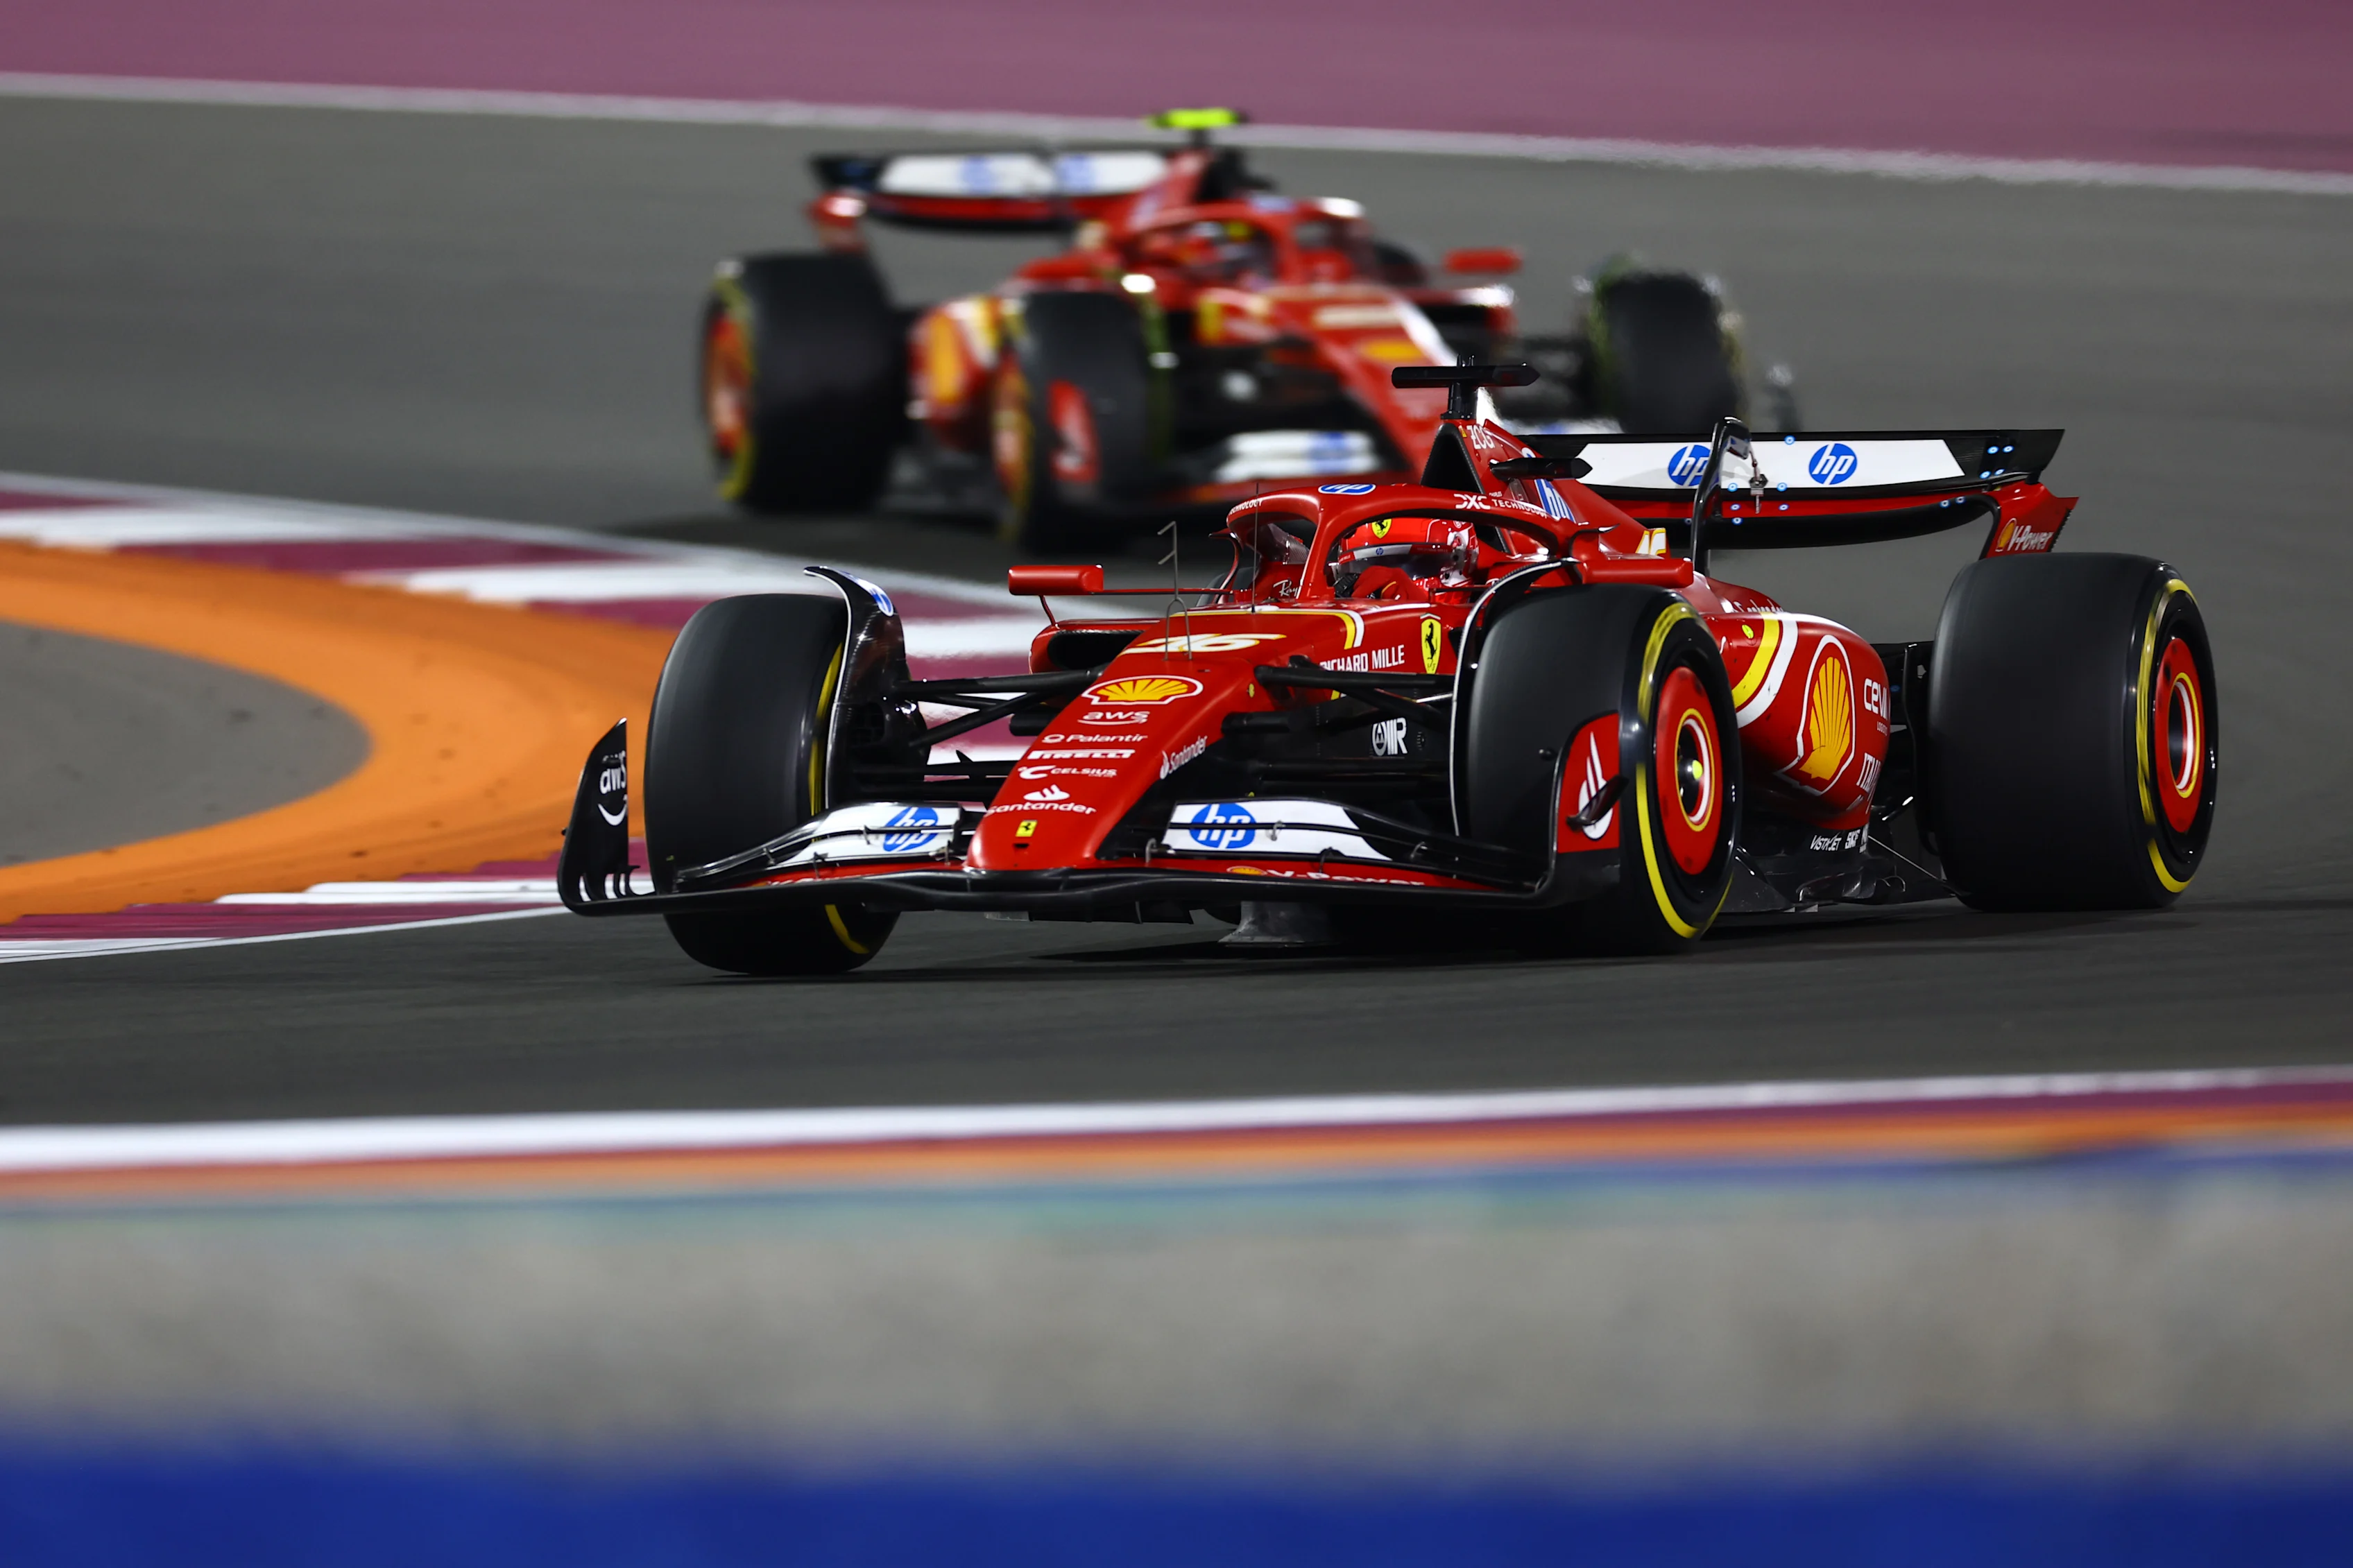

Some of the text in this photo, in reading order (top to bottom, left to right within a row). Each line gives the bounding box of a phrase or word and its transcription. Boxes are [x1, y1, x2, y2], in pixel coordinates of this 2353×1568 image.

[1811, 443, 1856, 485] hp
[1453, 493, 1491, 510] DXC
[1117, 632, 1287, 657] 16
[1371, 644, 1405, 670] MILLE
[1082, 711, 1151, 722] aws
[1066, 734, 1149, 743] Palantir
[1027, 749, 1136, 760] PIRELLI
[1169, 735, 1208, 774] Santander
[1050, 768, 1118, 777] CELSIUS
[885, 806, 936, 852] hp
[1196, 802, 1249, 849] hp
